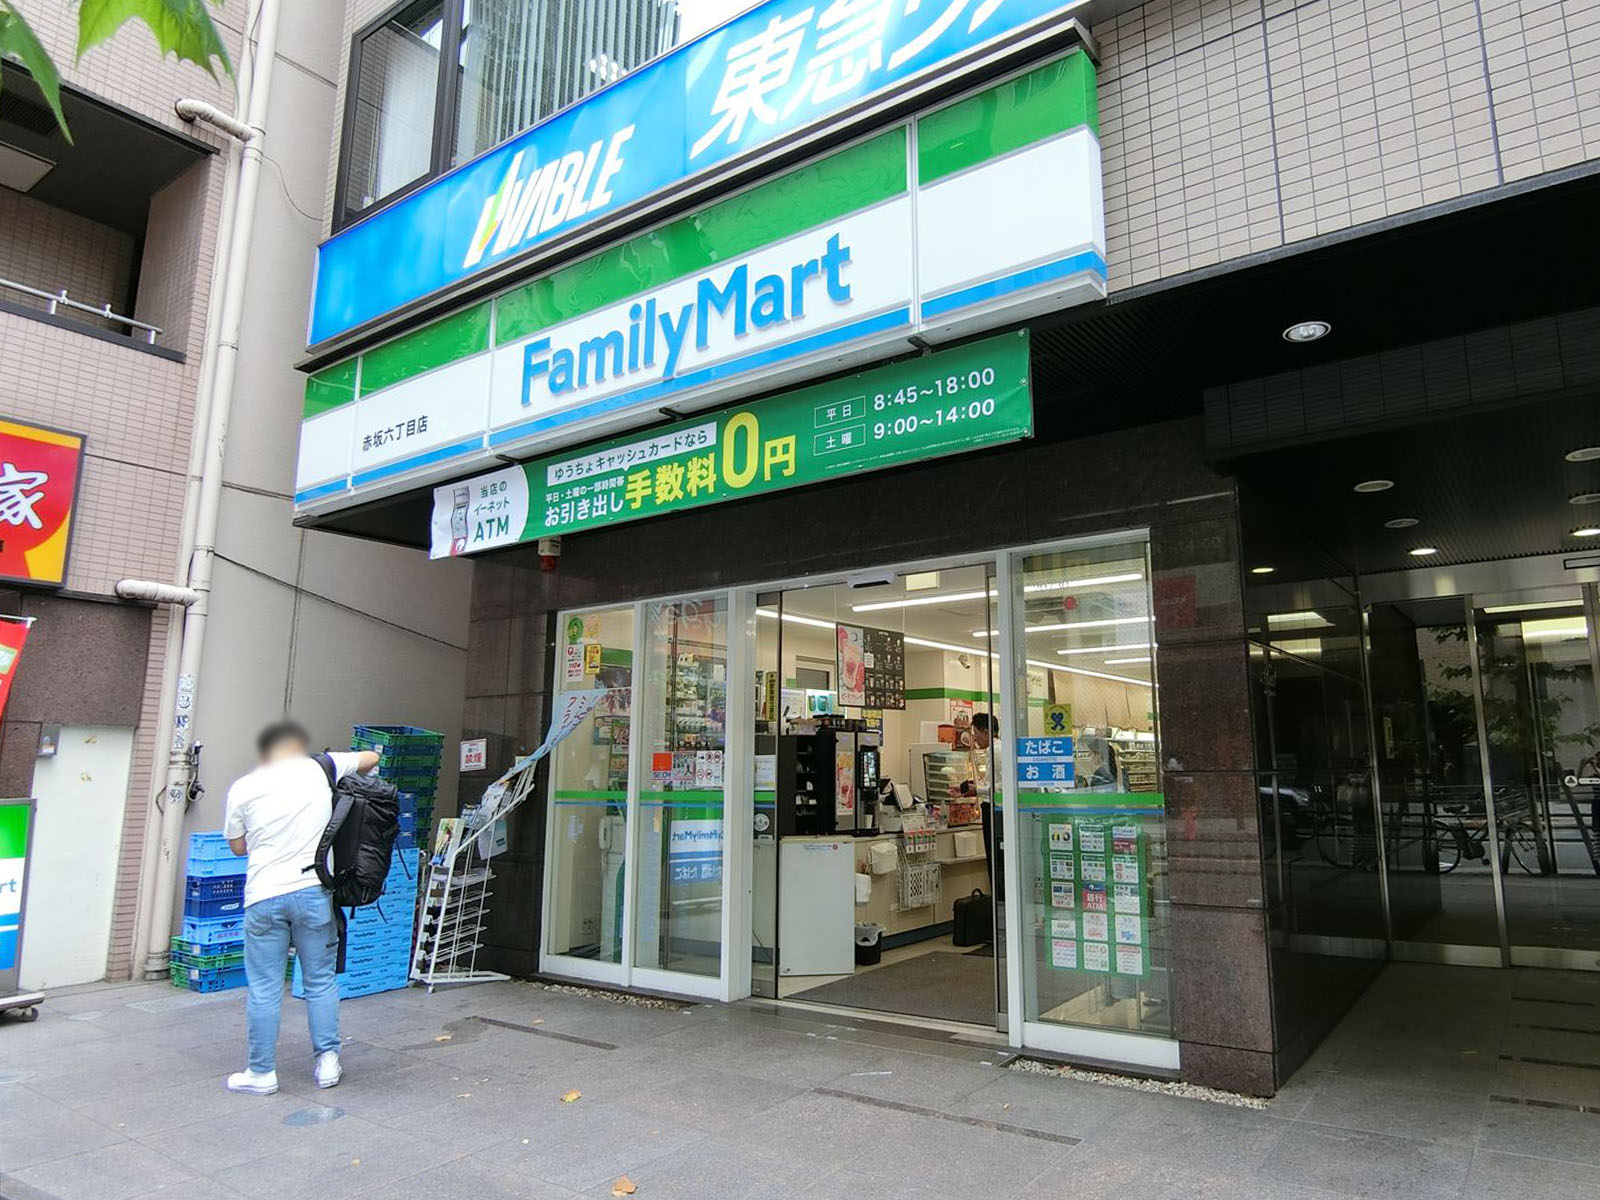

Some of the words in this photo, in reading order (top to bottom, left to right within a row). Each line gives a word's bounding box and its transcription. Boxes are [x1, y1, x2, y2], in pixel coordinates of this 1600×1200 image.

[521, 232, 852, 407] FamilyMart
[826, 404, 852, 420] 平日
[362, 415, 428, 452] 赤坂六丁目店
[826, 432, 852, 449] 土曜
[554, 429, 708, 481] ゆうちょキャッシュカードなら
[480, 480, 507, 499] 当店の
[473, 497, 510, 515] イーネット
[545, 492, 624, 527] お引き出し
[473, 515, 510, 542] ATM
[1025, 740, 1064, 754] たばこ
